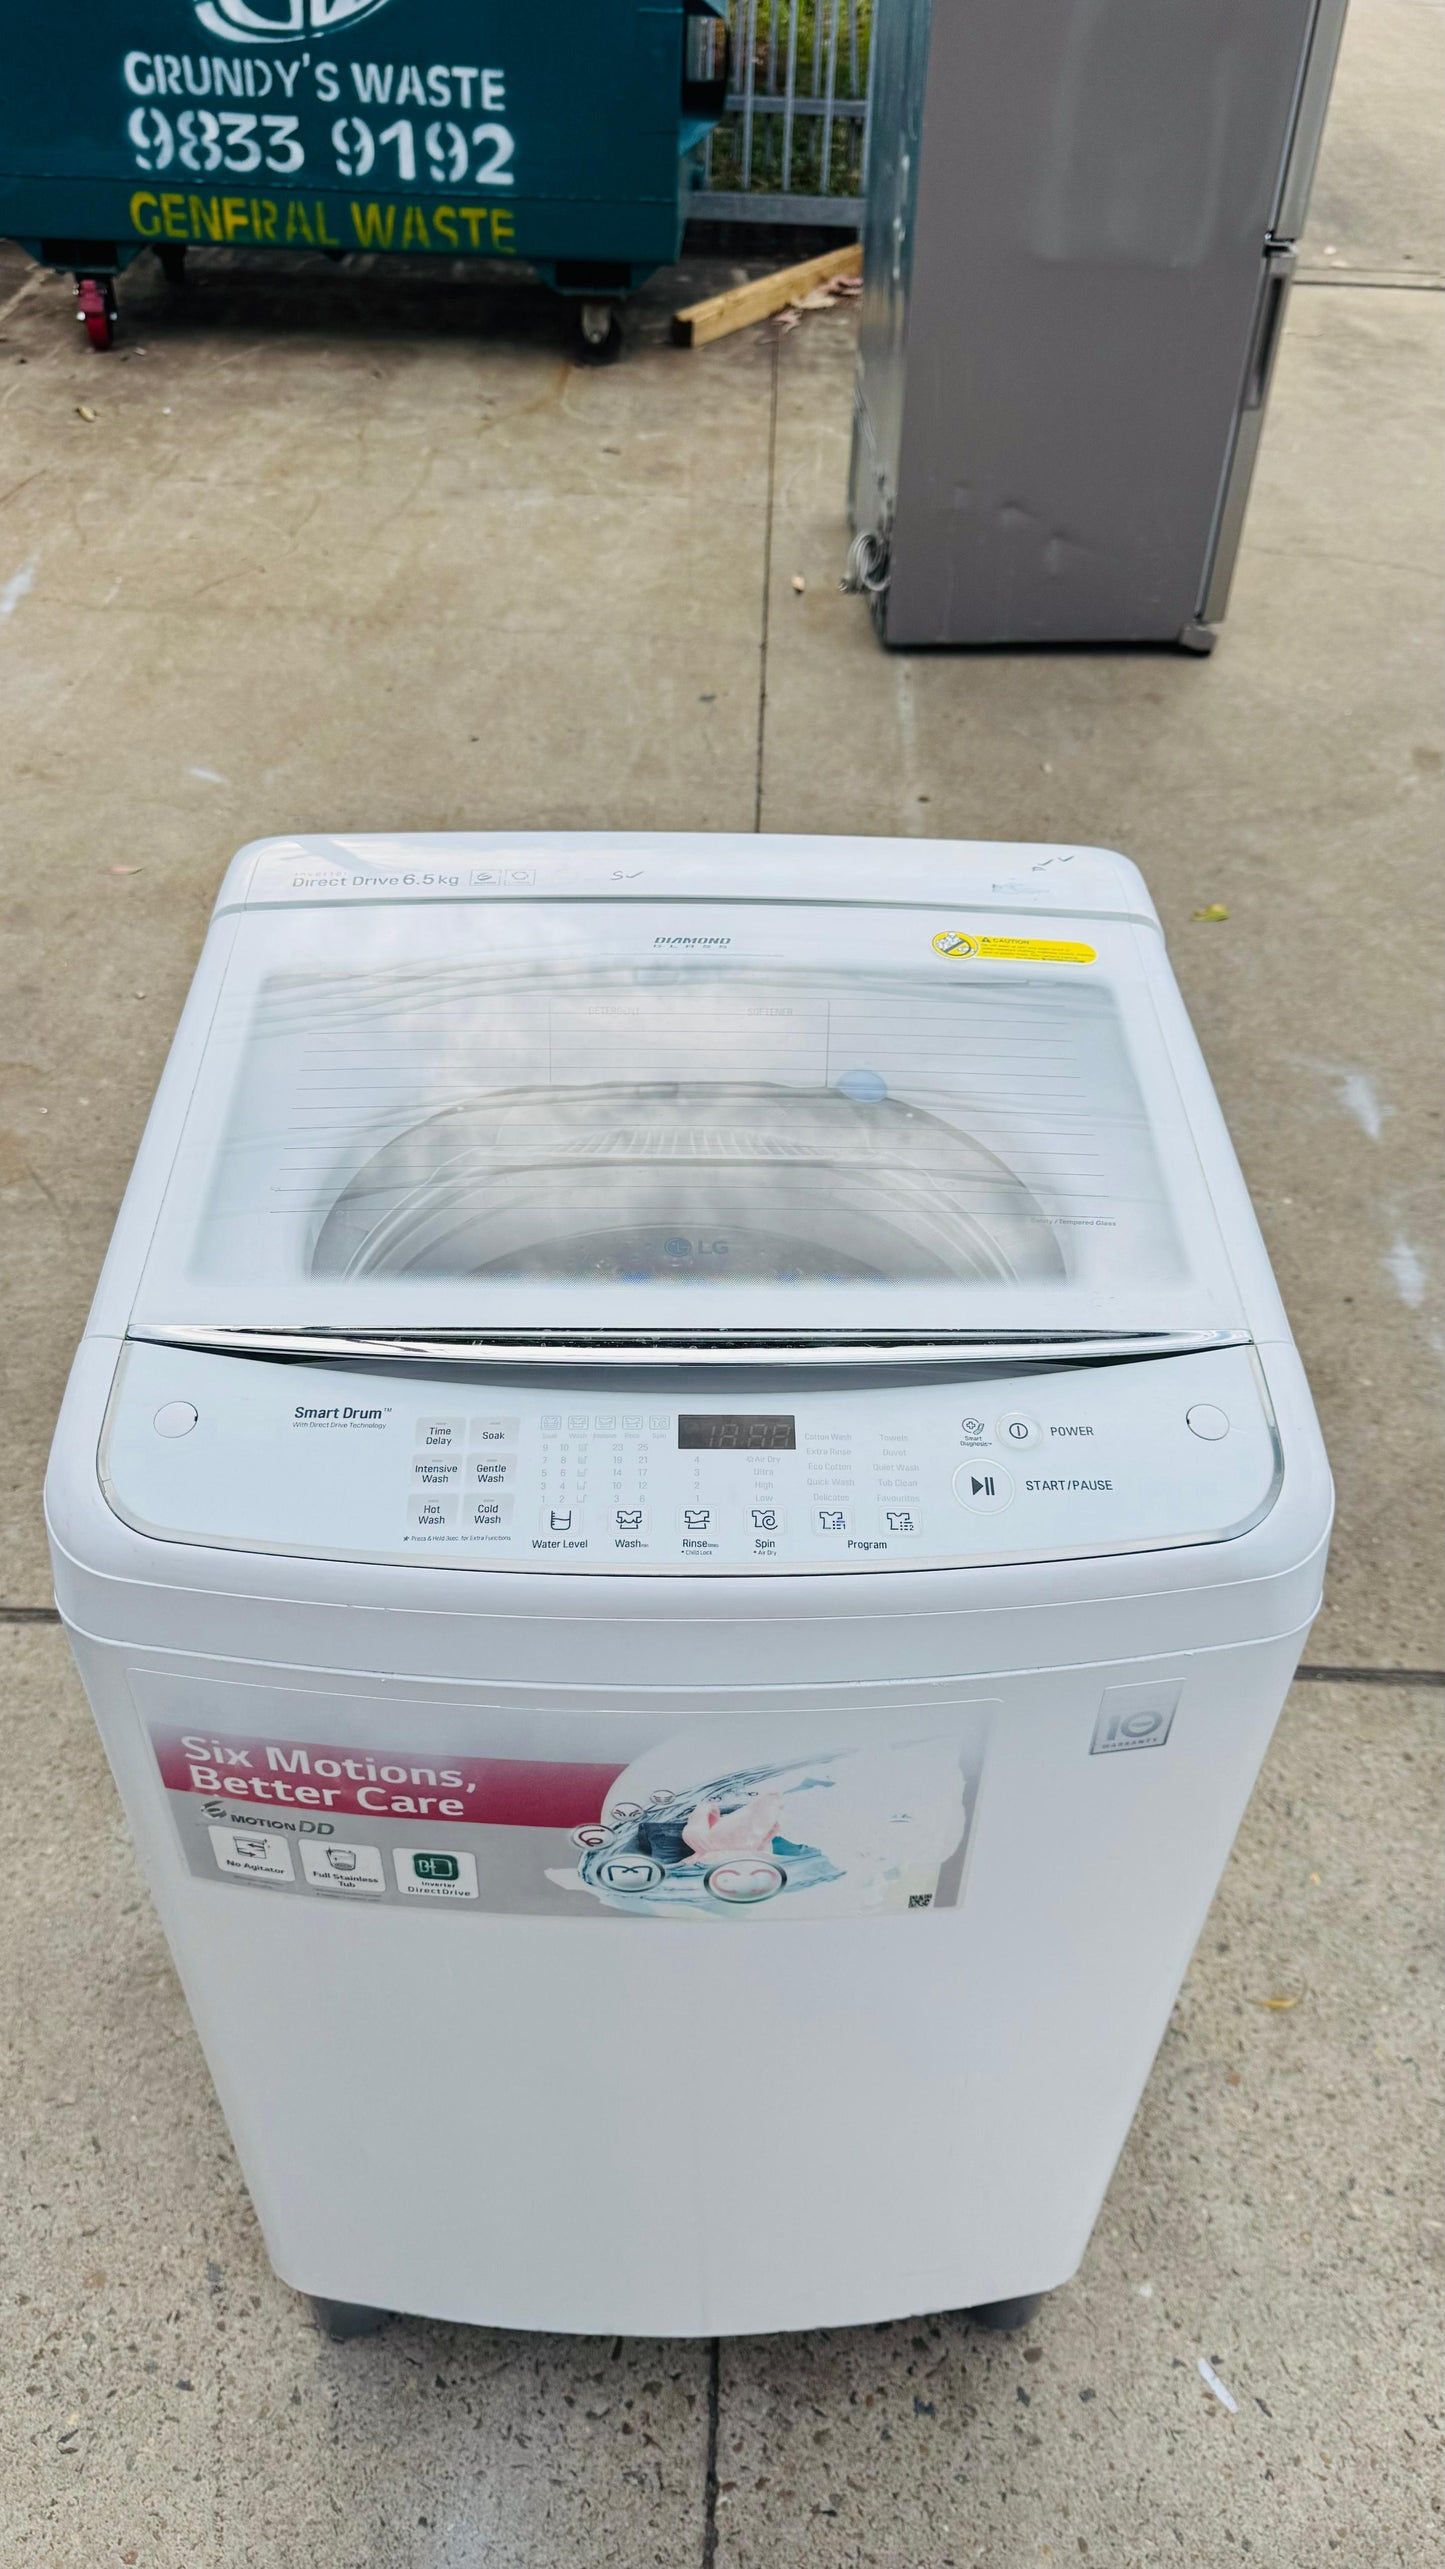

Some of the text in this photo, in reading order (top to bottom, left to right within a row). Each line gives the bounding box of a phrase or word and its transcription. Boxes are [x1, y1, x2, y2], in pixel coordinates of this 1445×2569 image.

[124, 50, 507, 112] GRUNDY'S WASTE
[127, 106, 515, 186] 9833 9192
[351, 202, 517, 255] WASTE
[292, 873, 459, 888] Direct Drive 6.5 kg
[654, 936, 731, 945] DIAMOND
[294, 1406, 340, 1419] Smart
[429, 1426, 452, 1436] Time
[482, 1431, 505, 1441] Soak
[1050, 1426, 1095, 1437] POWER
[425, 1436, 453, 1447] Delay
[414, 1464, 458, 1473] Intensive
[476, 1464, 507, 1473] Gentle
[421, 1474, 449, 1483] Wash
[477, 1473, 505, 1483] Wash
[1025, 1480, 1114, 1491] START/PAUSE
[423, 1505, 441, 1514] Hot
[477, 1504, 499, 1514] Cold
[418, 1515, 446, 1525] Wash
[474, 1515, 502, 1524] Wash
[532, 1539, 588, 1549] Water Level
[614, 1538, 641, 1548] Wash
[682, 1538, 708, 1548] Rinse
[755, 1538, 776, 1549] Spin
[847, 1539, 887, 1551] Program
[180, 1735, 477, 1794] Six Motions,
[189, 1764, 465, 1817] Better Care
[230, 1814, 297, 1832] MOTION
[298, 1820, 335, 1836] DD
[226, 1859, 284, 1875] No Agitator
[313, 1870, 379, 1884] Full Stainless
[338, 1880, 356, 1888] Tub
[421, 1881, 456, 1889] Inverter
